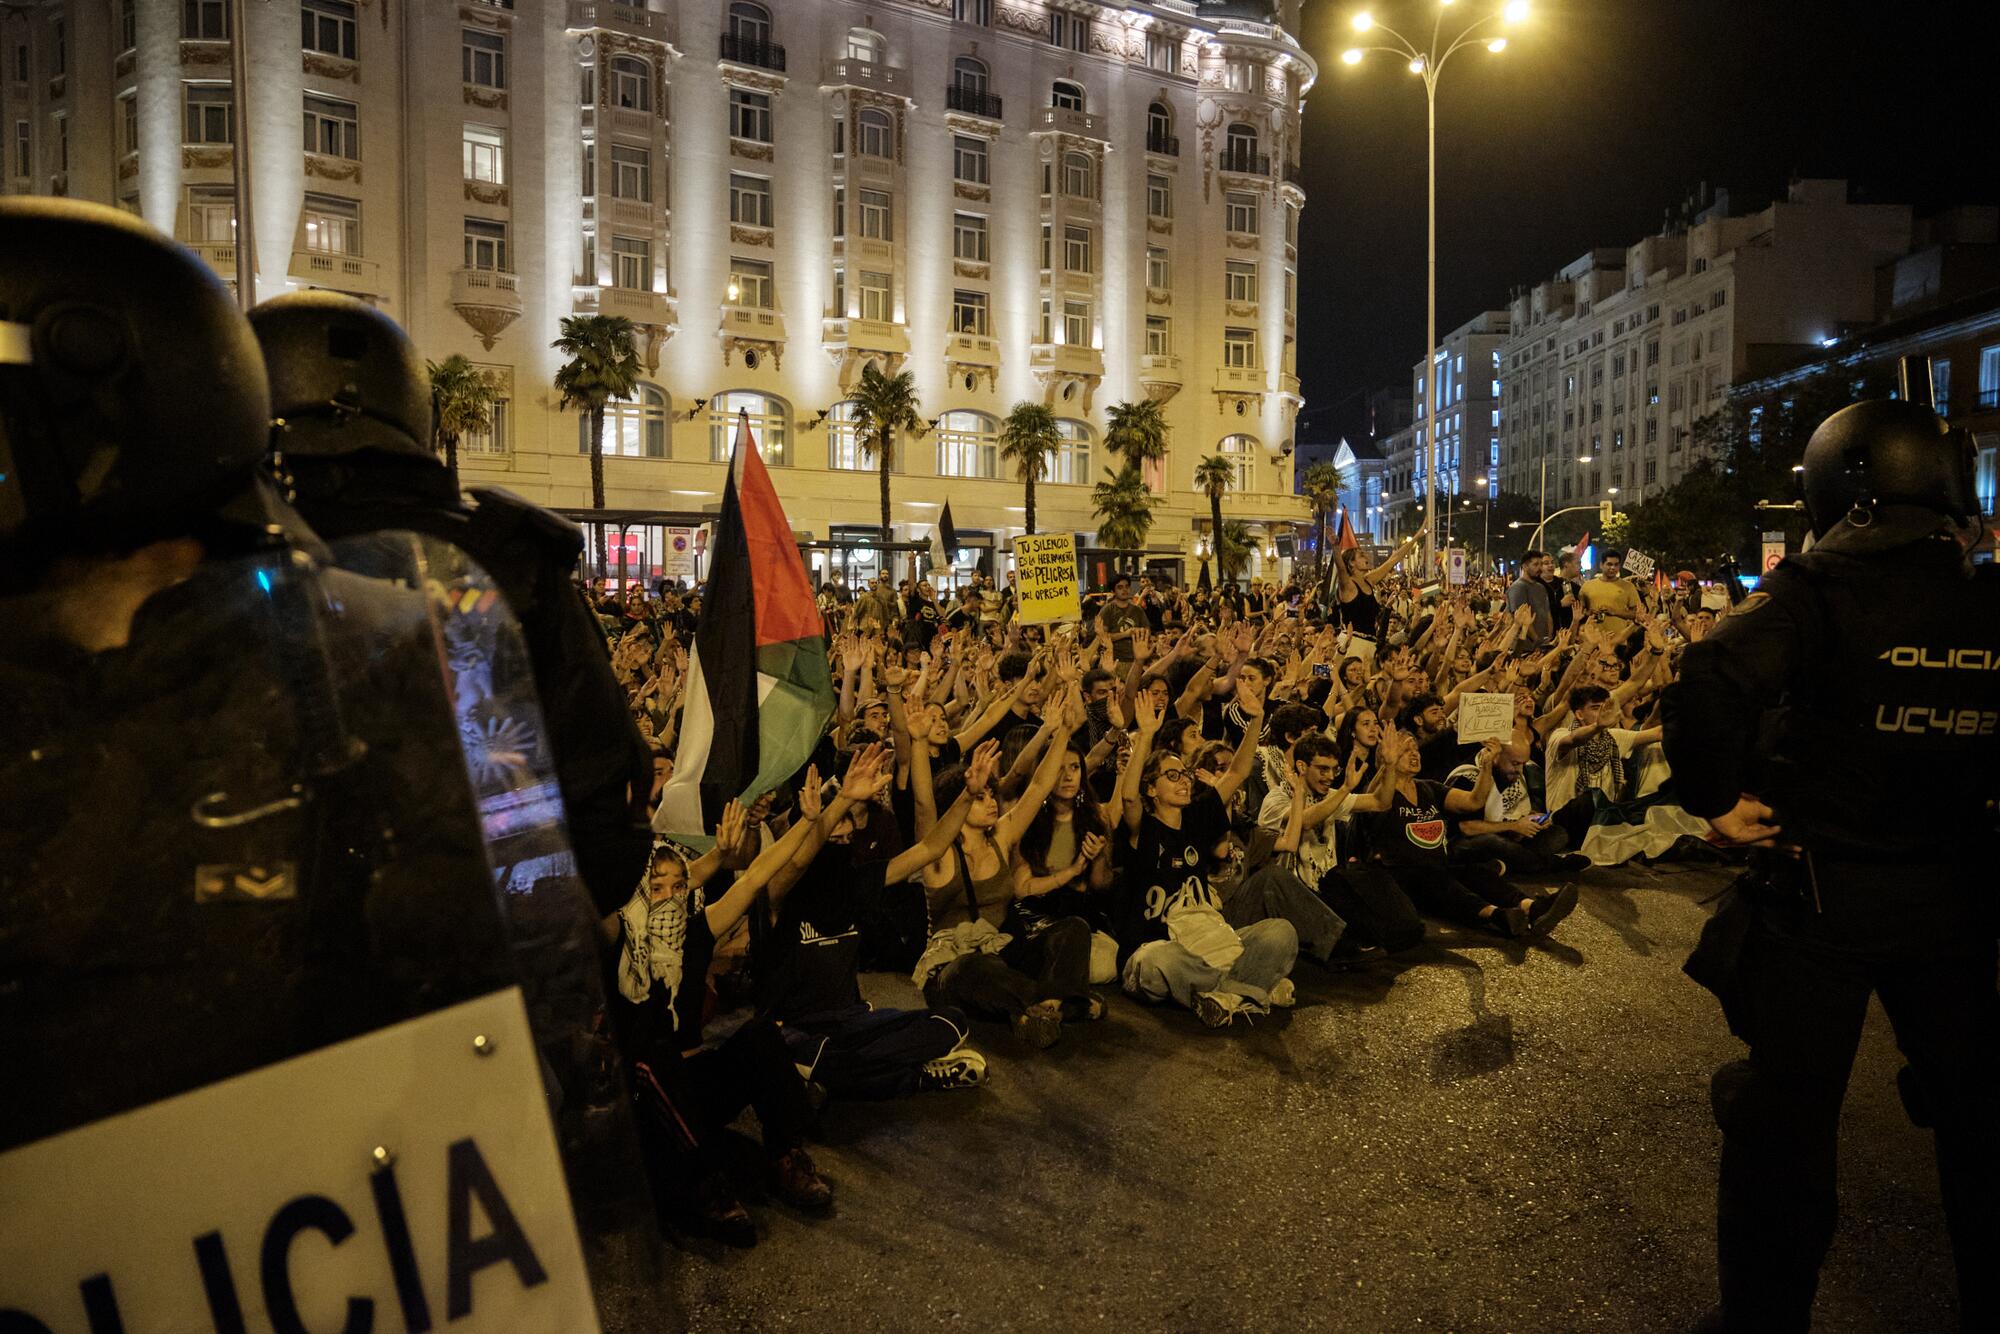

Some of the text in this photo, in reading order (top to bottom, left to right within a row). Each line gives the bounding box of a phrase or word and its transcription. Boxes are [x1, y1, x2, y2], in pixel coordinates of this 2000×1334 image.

[1018, 539, 1069, 554] TU SILENCIO
[1019, 556, 1028, 567] ES
[1035, 566, 1075, 585] PELIGROSA
[1022, 586, 1070, 600] DEL OPRESOR
[1878, 647, 2000, 670] OLICI
